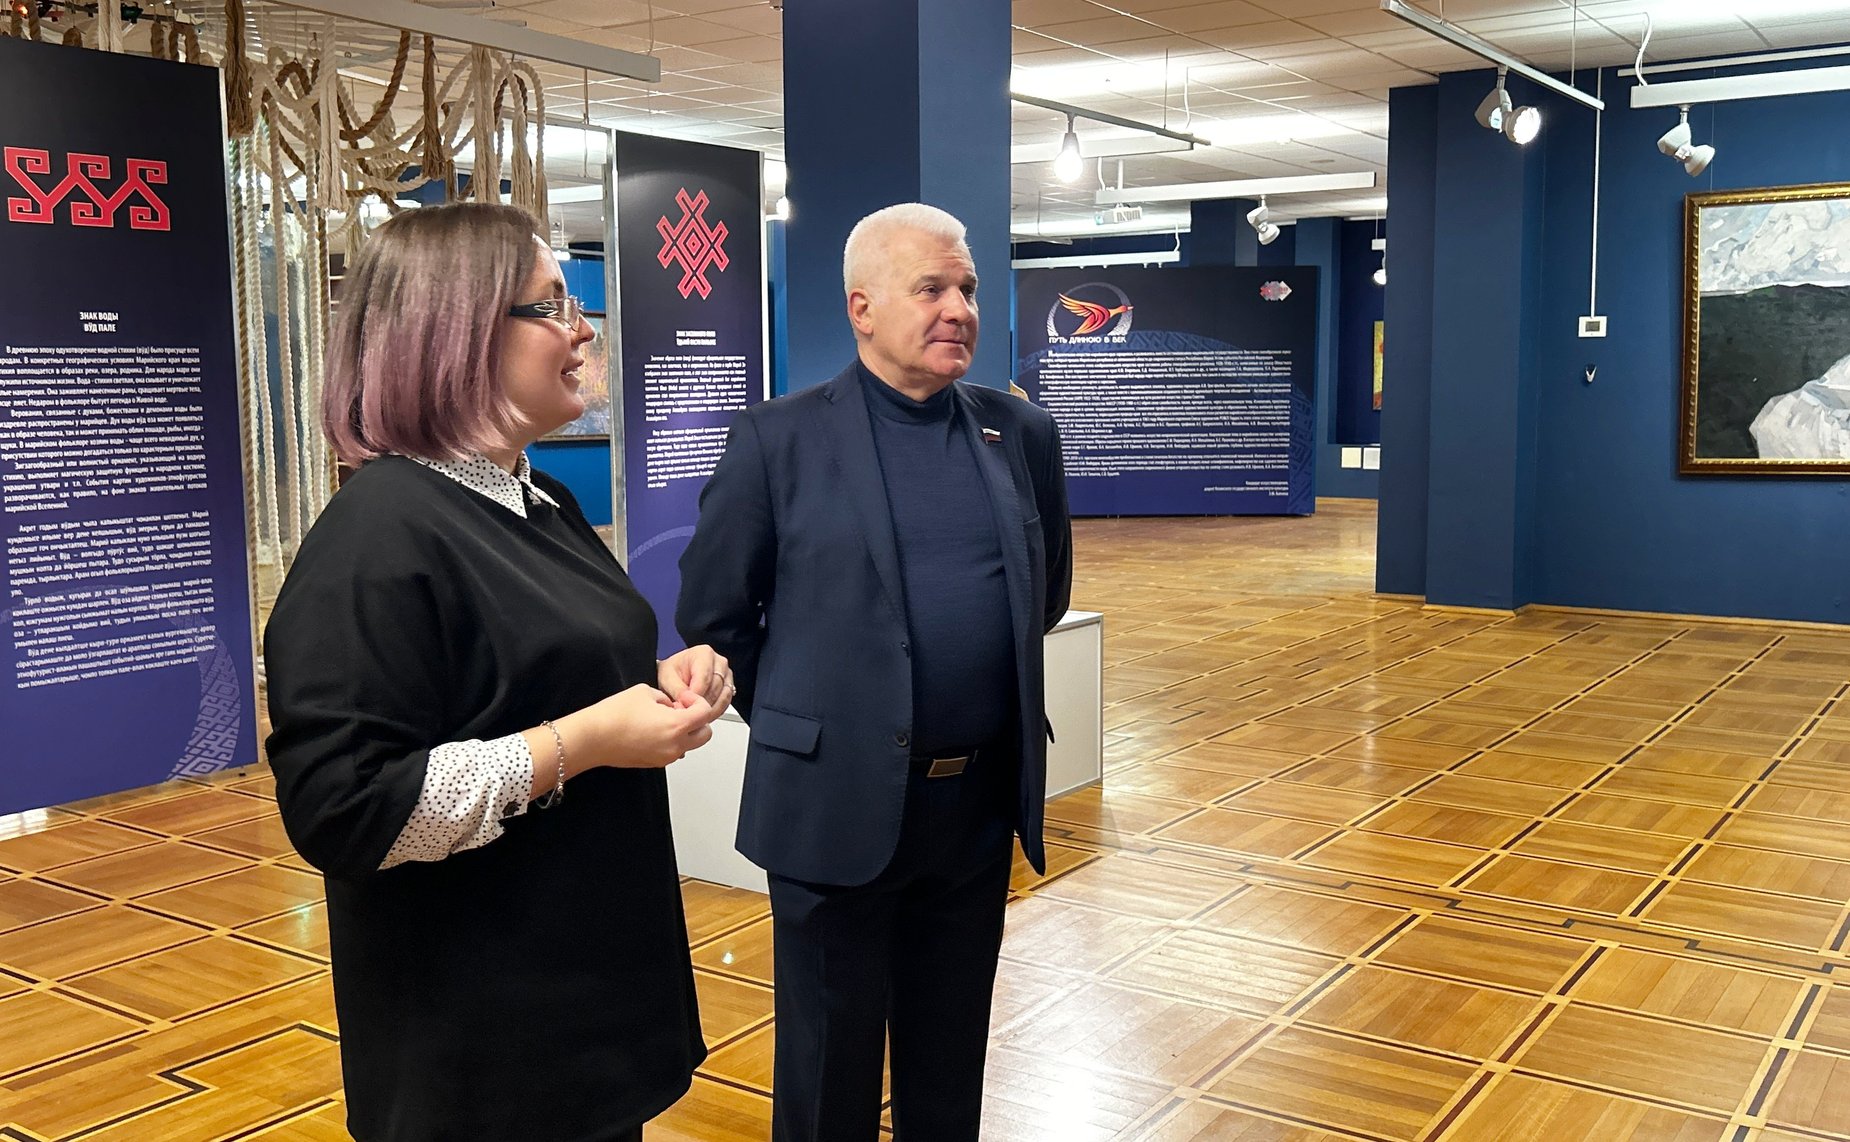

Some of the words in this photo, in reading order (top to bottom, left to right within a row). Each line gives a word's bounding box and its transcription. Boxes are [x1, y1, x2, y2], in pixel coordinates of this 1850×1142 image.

[80, 312, 98, 320] ЗНАК
[98, 312, 118, 321] ВОДЫ
[98, 324, 116, 332] ПАЛЕ
